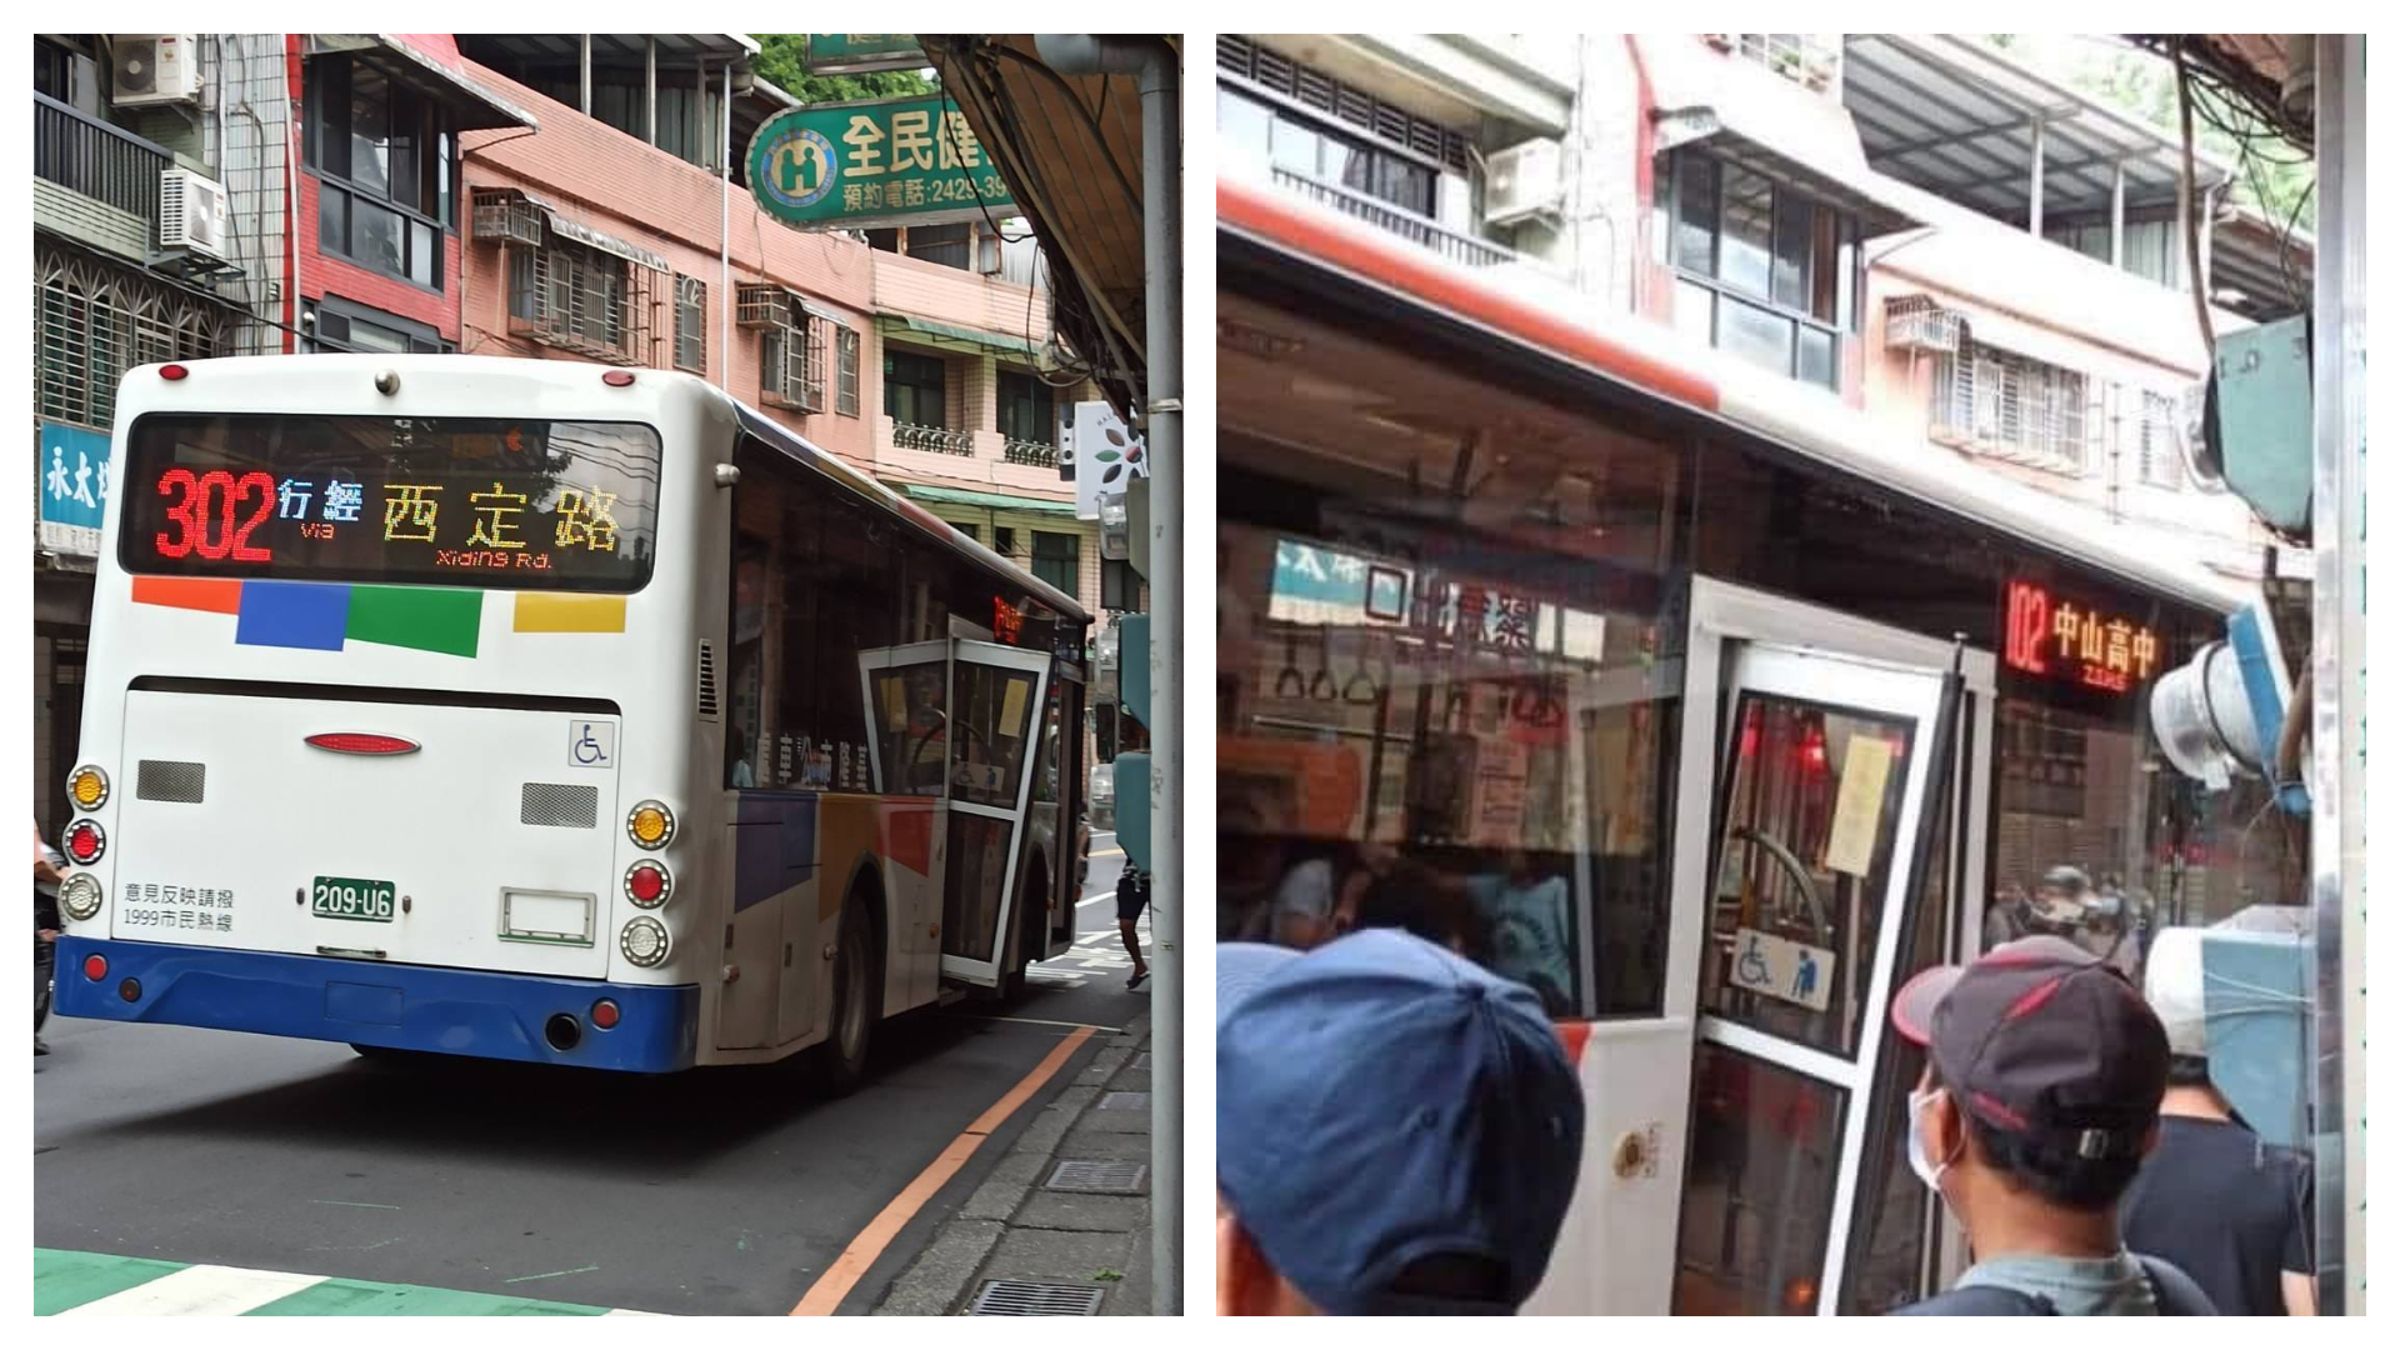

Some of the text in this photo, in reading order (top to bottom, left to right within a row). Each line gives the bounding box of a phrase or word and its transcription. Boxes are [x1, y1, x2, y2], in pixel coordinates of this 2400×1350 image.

[842, 110, 997, 178] 全民健
[156, 469, 275, 561] 302
[277, 479, 363, 521] 行經
[384, 482, 619, 551] 西定路
[515, 553, 552, 569] Rd.
[2006, 581, 2155, 679] 102 中山高中
[125, 884, 233, 908] 意見反映請撥
[315, 884, 391, 916] 209-U6
[124, 909, 232, 932] 1999市民熱線
